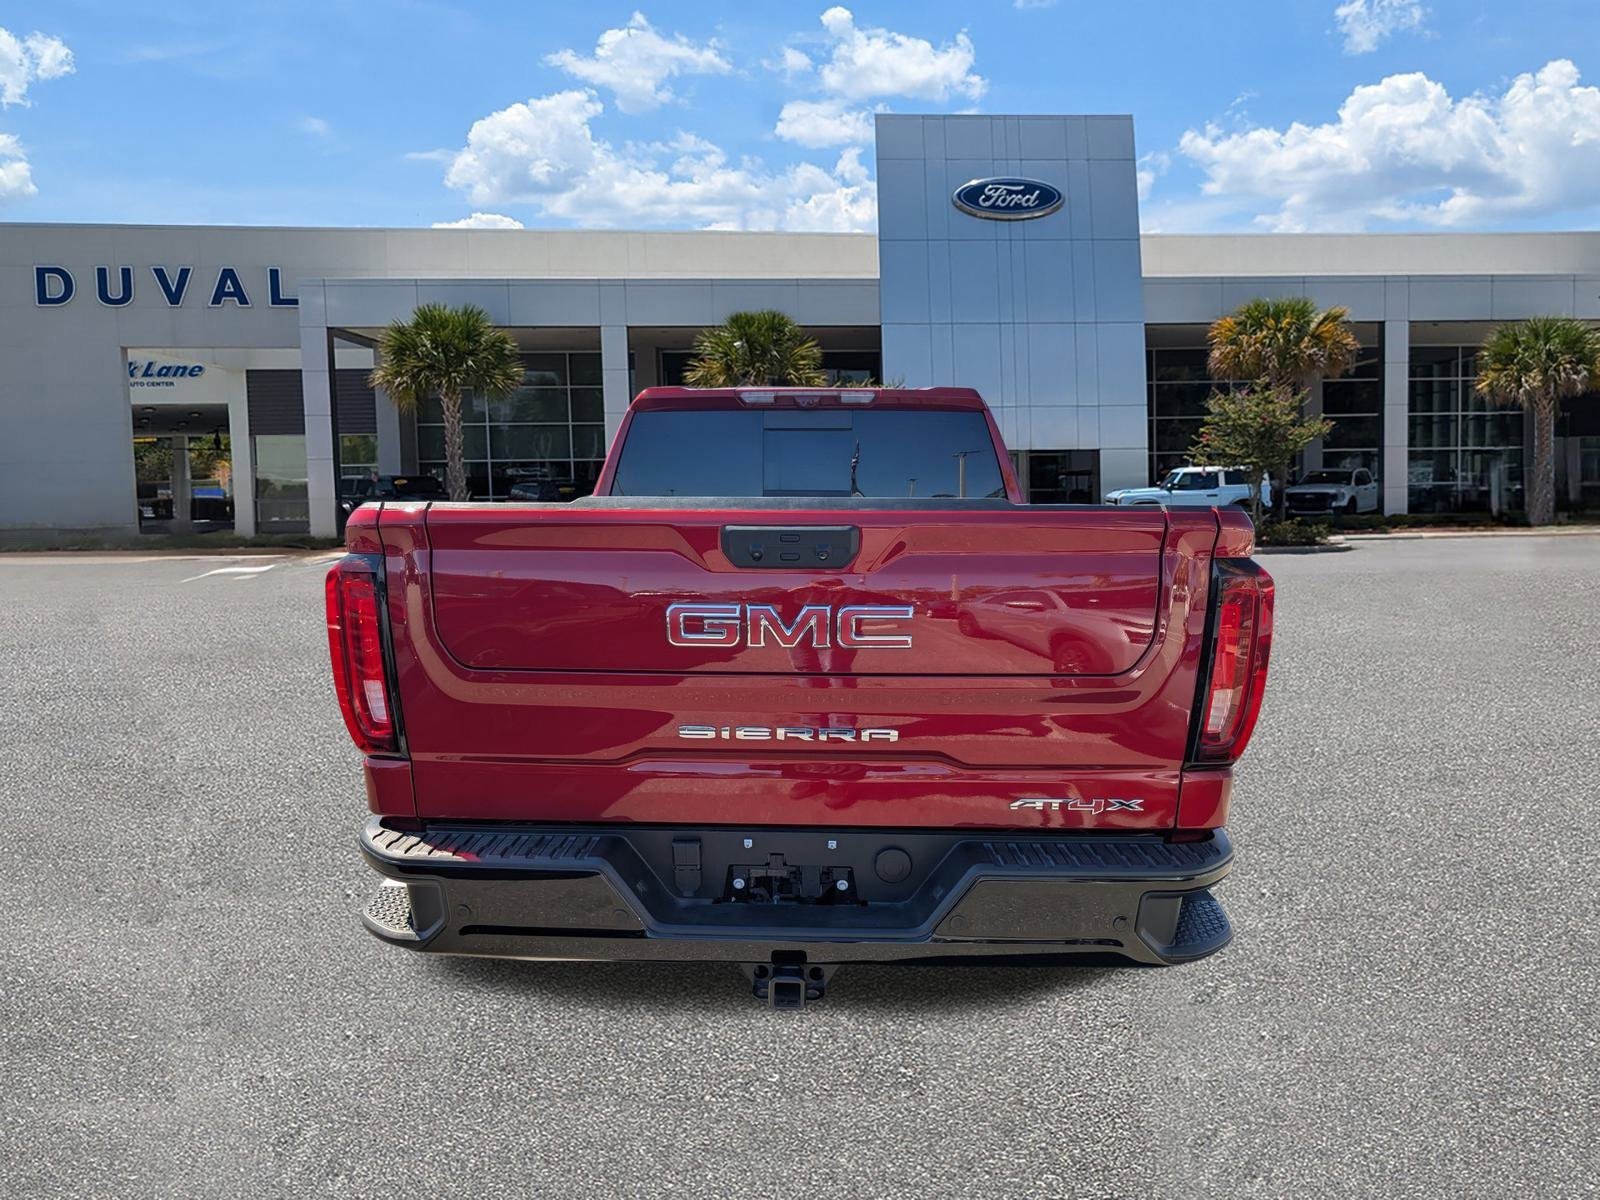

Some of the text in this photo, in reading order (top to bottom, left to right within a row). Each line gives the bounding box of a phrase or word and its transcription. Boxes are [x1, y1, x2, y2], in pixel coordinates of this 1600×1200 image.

[978, 184, 1040, 207] Ford
[33, 265, 299, 307] DUVAL
[141, 361, 206, 378] Lane
[666, 603, 914, 649] GMC
[678, 725, 899, 742] SIERRA
[1009, 798, 1145, 815] AT4X
